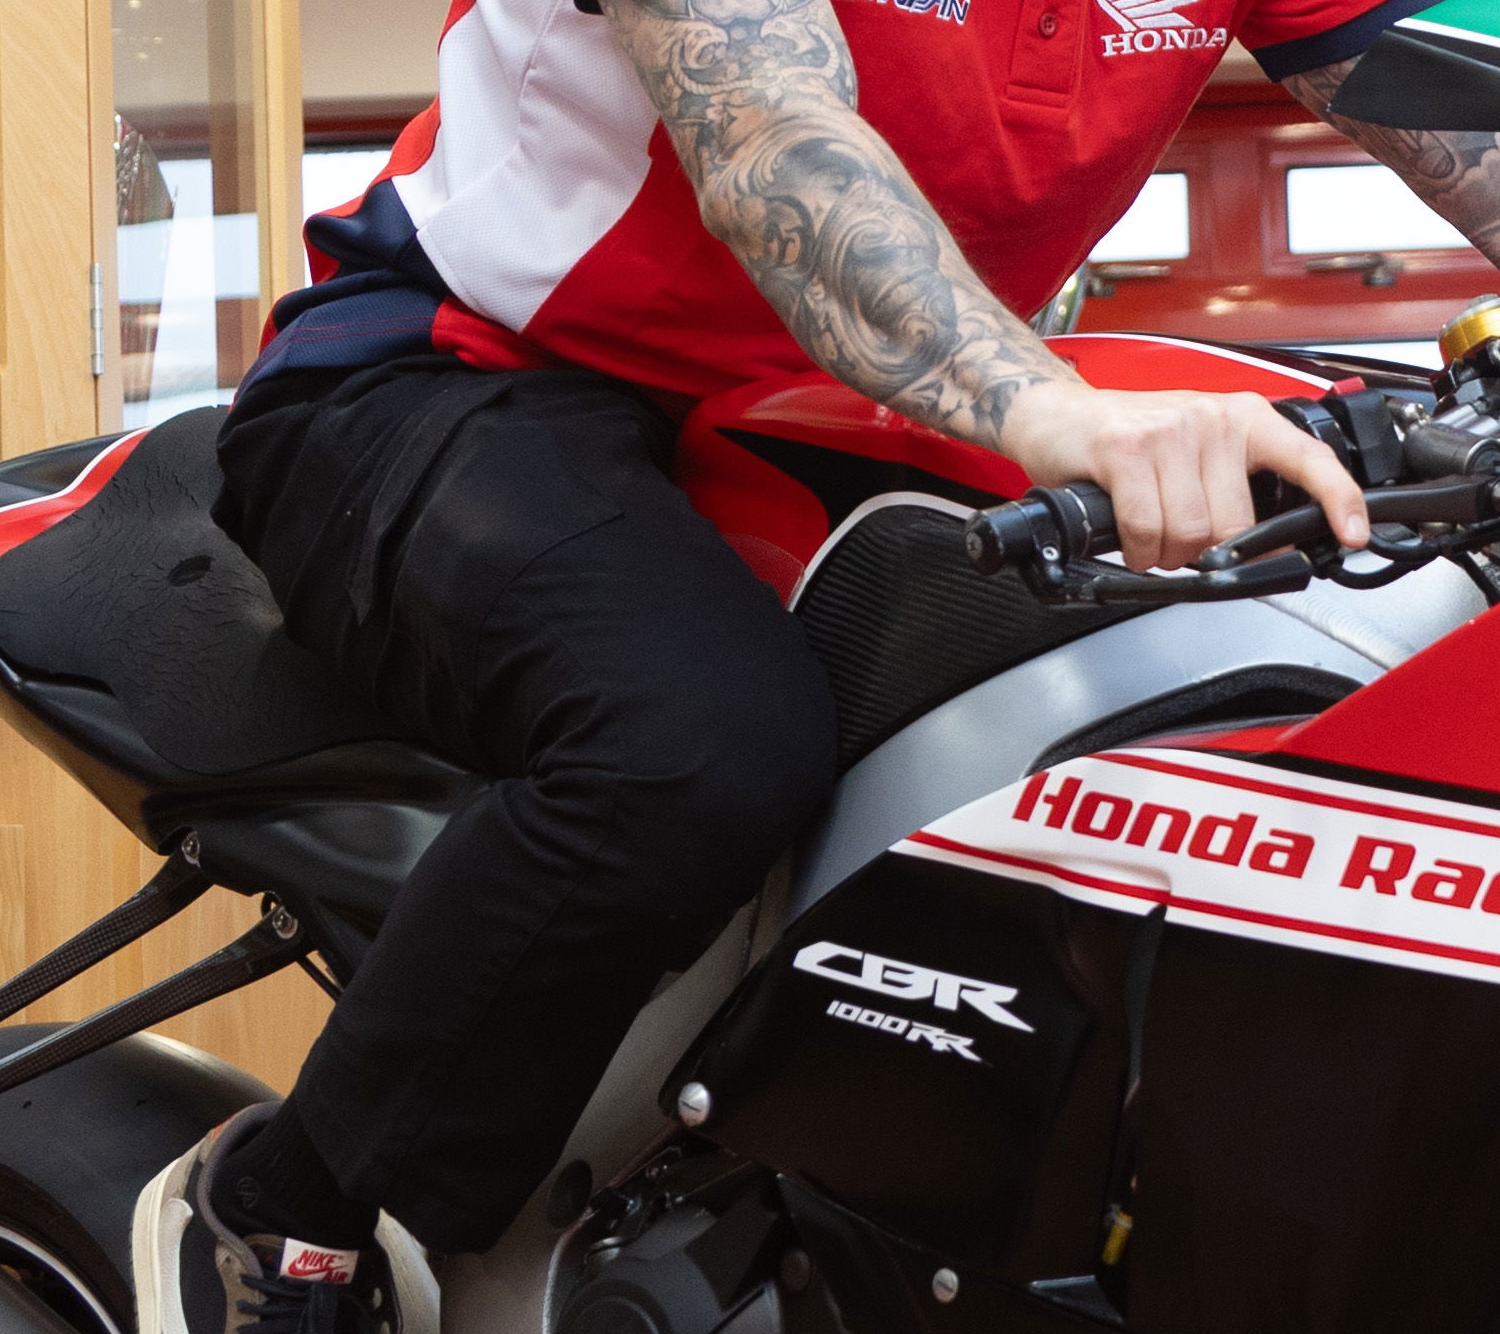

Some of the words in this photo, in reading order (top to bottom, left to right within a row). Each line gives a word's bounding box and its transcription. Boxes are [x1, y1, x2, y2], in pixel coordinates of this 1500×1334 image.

[1100, 26, 1228, 58] HONDA
[1011, 769, 1315, 879] Honda
[793, 940, 1035, 1032] CBR
[826, 1000, 983, 1063] 1000RR
[297, 1249, 337, 1269] NIKE
[322, 1269, 348, 1282] AIR
